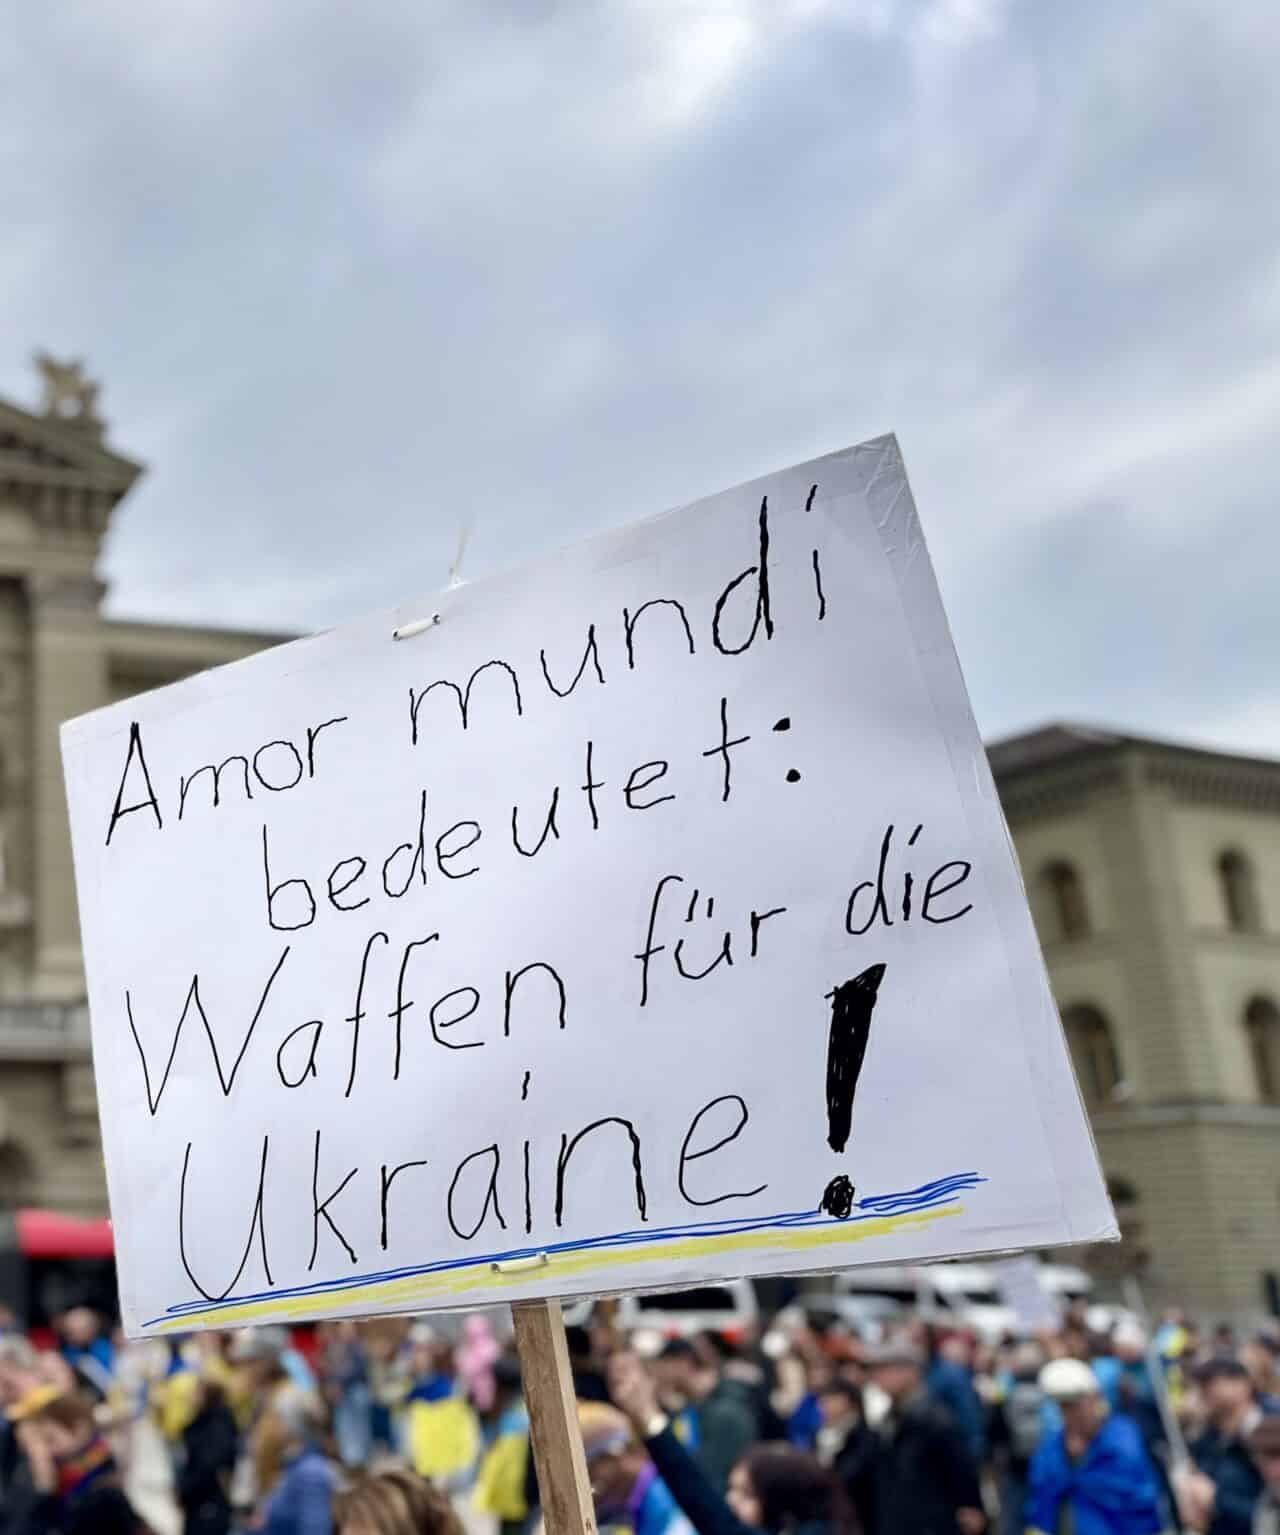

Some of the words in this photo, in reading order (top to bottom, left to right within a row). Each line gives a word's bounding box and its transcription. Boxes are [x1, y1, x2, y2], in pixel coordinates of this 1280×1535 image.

[104, 716, 350, 847] Amor
[408, 483, 827, 746] mundi
[262, 696, 803, 932] bedeutet:
[125, 931, 568, 1117] Waffen
[632, 874, 788, 1008] für
[844, 823, 974, 937] die
